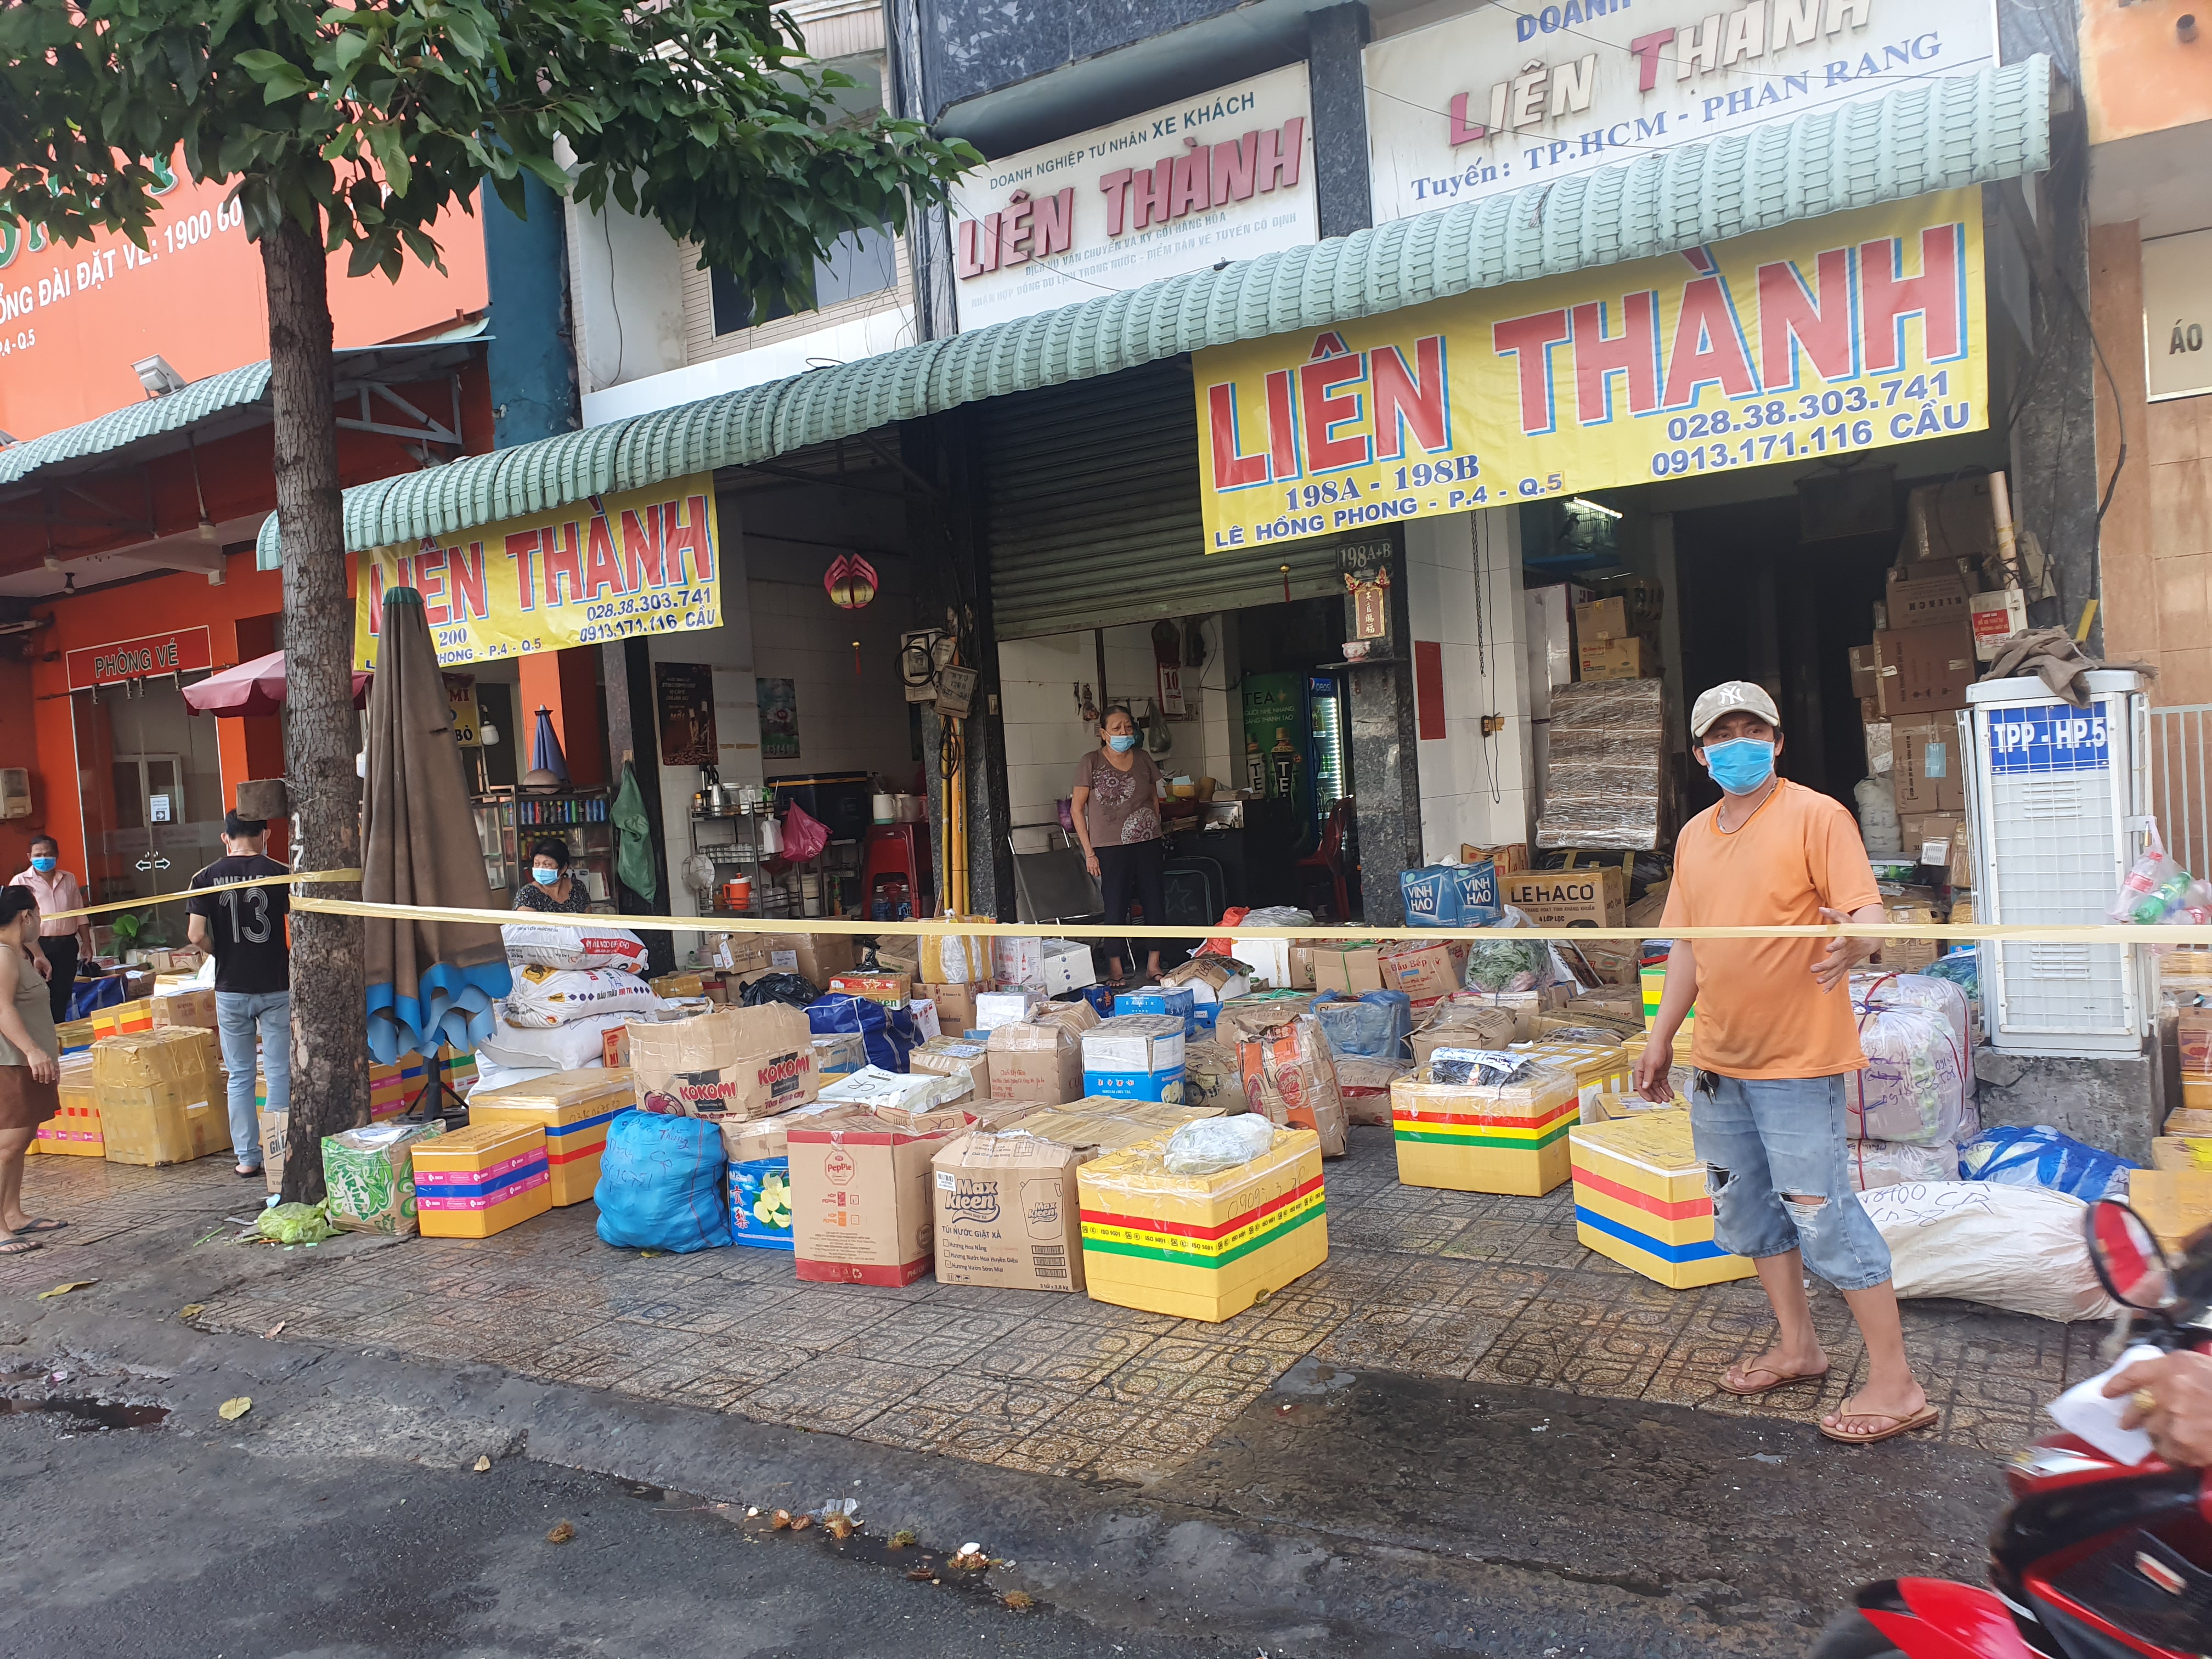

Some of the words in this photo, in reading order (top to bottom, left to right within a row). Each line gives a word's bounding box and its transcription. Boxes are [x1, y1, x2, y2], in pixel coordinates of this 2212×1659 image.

[1451, 54, 1596, 146] LIÊN
[1524, 111, 1668, 171] TP.HCM
[1702, 71, 1810, 122] PHAN
[1824, 31, 1942, 88] RANG
[990, 166, 1032, 190] DOANH
[1037, 151, 1085, 176] NGHIỆP
[1089, 140, 1105, 159] TƯ
[1110, 130, 1147, 152] NHÂN
[1153, 117, 1177, 138] XE
[1184, 92, 1254, 129] KHÁCH
[960, 187, 1075, 280] LIÊN
[1100, 116, 1305, 237] THÀNH
[38, 267, 71, 307] ĐÀI
[76, 248, 116, 290] ĐẶT
[165, 210, 211, 254] 1900
[2169, 319, 2203, 355] ÁO
[1207, 330, 1447, 493] LIÊN
[1491, 221, 1970, 435] THÀNH
[1668, 371, 1948, 441] 028.38.303.741
[1652, 420, 1872, 477] 0913.171.116
[1889, 400, 1970, 439] CẦU
[1285, 477, 1362, 512] 198A
[1393, 453, 1480, 492] 198B
[1215, 524, 1245, 549] LÊ
[1256, 515, 1324, 541] HỒNG
[1333, 497, 1418, 528] PHONG
[1449, 486, 1487, 508] P.4
[1518, 473, 1562, 497] Q.5
[505, 495, 714, 612] THÀNH
[587, 588, 711, 622] 028.38.303.741
[439, 628, 467, 647] 200
[580, 616, 678, 643] 0913.171.116
[685, 607, 715, 628] CẦU
[94, 646, 151, 679] PHÒNG
[156, 637, 179, 667] VÉ
[489, 644, 507, 657] P.4
[522, 638, 541, 652] Q.5
[1165, 672, 1179, 690] 10
[1316, 682, 1331, 692] pepsi
[1994, 723, 2035, 753] TPP
[2056, 718, 2106, 750] HP.5
[1511, 884, 1594, 903] LEHACO
[219, 887, 272, 944] 13
[679, 1081, 737, 1101] KOKOMI
[758, 1056, 811, 1087] KOKOMI
[956, 1178, 998, 1196] Max
[942, 1226, 952, 1234] TÚI
[953, 1225, 973, 1237] NƯỚC
[974, 1231, 989, 1240] GIẶT
[992, 1229, 1002, 1239] XẢ
